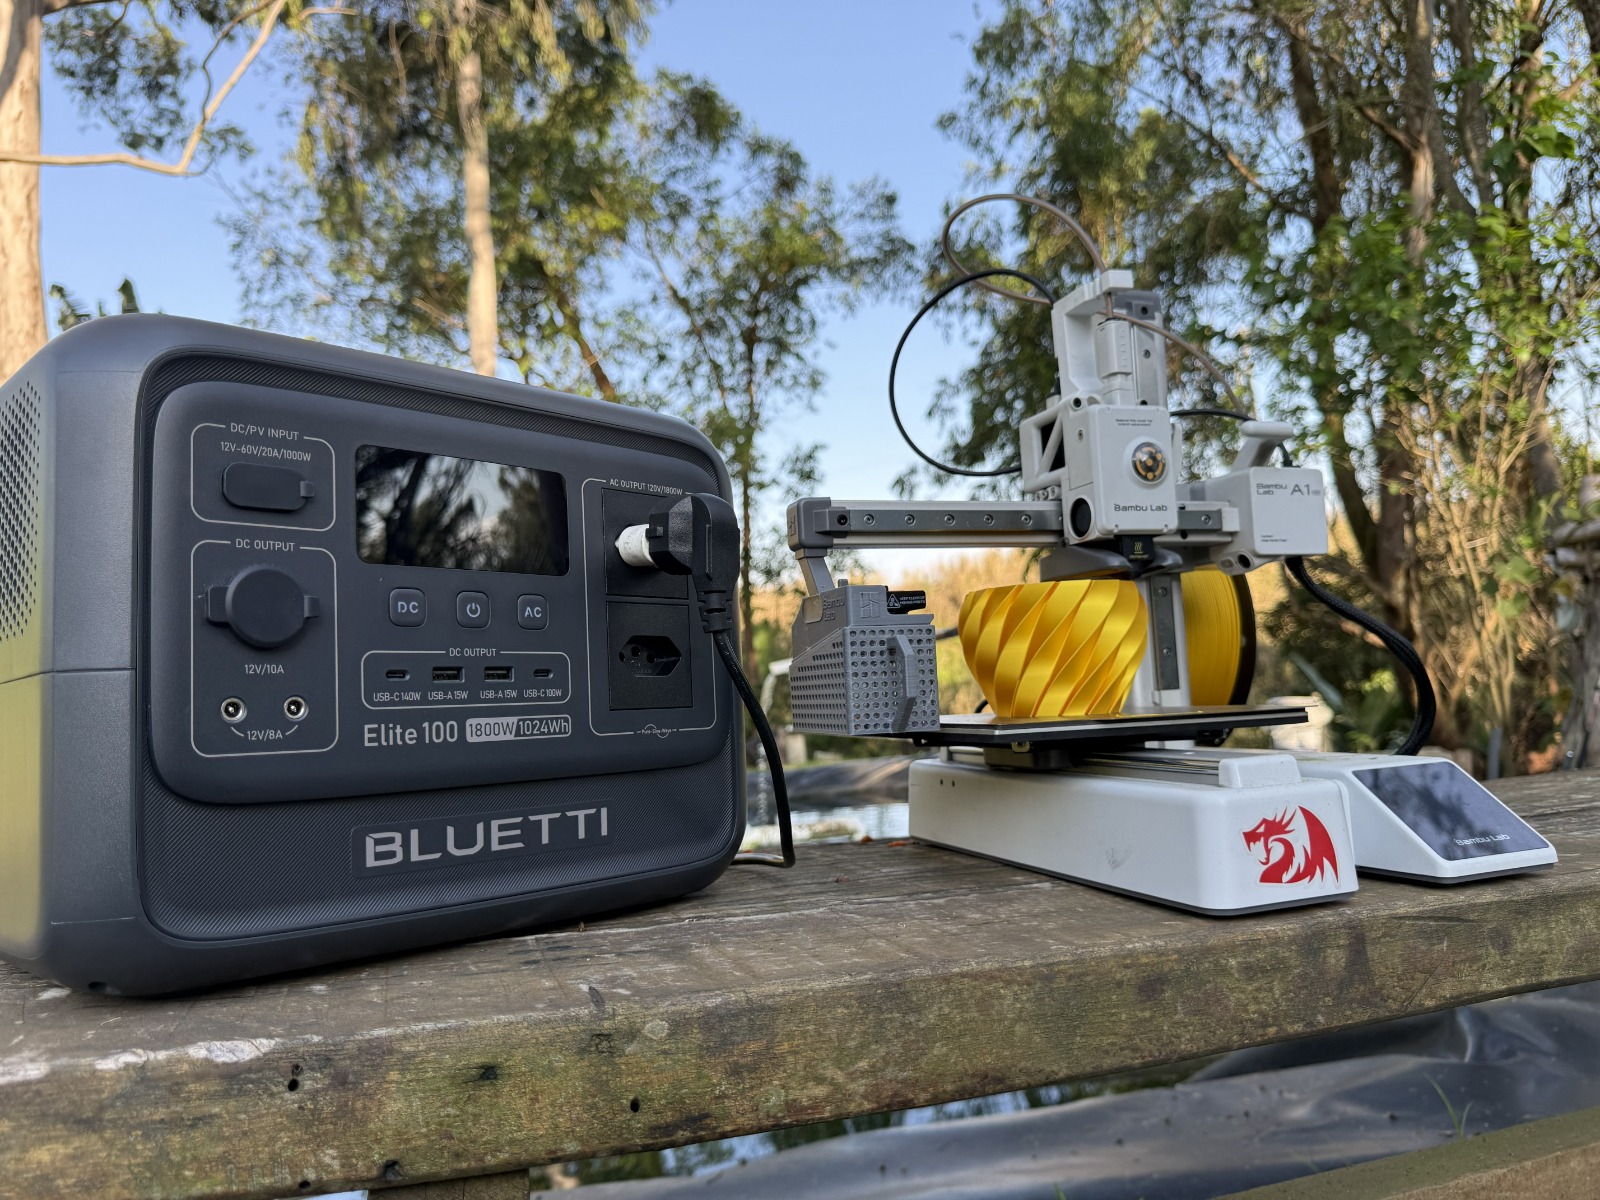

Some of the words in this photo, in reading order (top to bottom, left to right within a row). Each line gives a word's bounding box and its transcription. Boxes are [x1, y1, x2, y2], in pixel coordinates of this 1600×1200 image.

[230, 423, 265, 436] DC/PV
[268, 427, 300, 441] INPUT
[609, 478, 619, 487] AC
[620, 480, 646, 491] OUTPUT
[647, 483, 683, 496] 120V/1800W
[1290, 483, 1310, 496] A1
[1113, 503, 1148, 512] Bambu
[1150, 504, 1168, 512] Lab
[235, 538, 251, 549] DC
[254, 539, 296, 552] OUTPUT
[397, 601, 419, 614] DC
[524, 606, 542, 618] AC
[449, 648, 462, 657] DC
[463, 648, 497, 658] OUTPUT
[244, 664, 285, 676] 12V/10A
[373, 692, 400, 702] USB-C
[401, 691, 422, 701] 140W
[427, 691, 453, 700] USB-A
[453, 690, 469, 700] 15W
[479, 689, 504, 699] USB-A
[504, 689, 518, 698] 15W
[523, 688, 545, 698] USB-C
[545, 688, 563, 697] 100W
[246, 730, 283, 741] 12V/8A
[364, 723, 418, 747] Elite
[422, 720, 459, 744] 100
[468, 720, 516, 738] 1800W
[518, 718, 570, 736] 1024Wh
[365, 807, 608, 868] BLUETTI
[1453, 836, 1491, 846] Bambu
[1489, 833, 1511, 841] Lab
